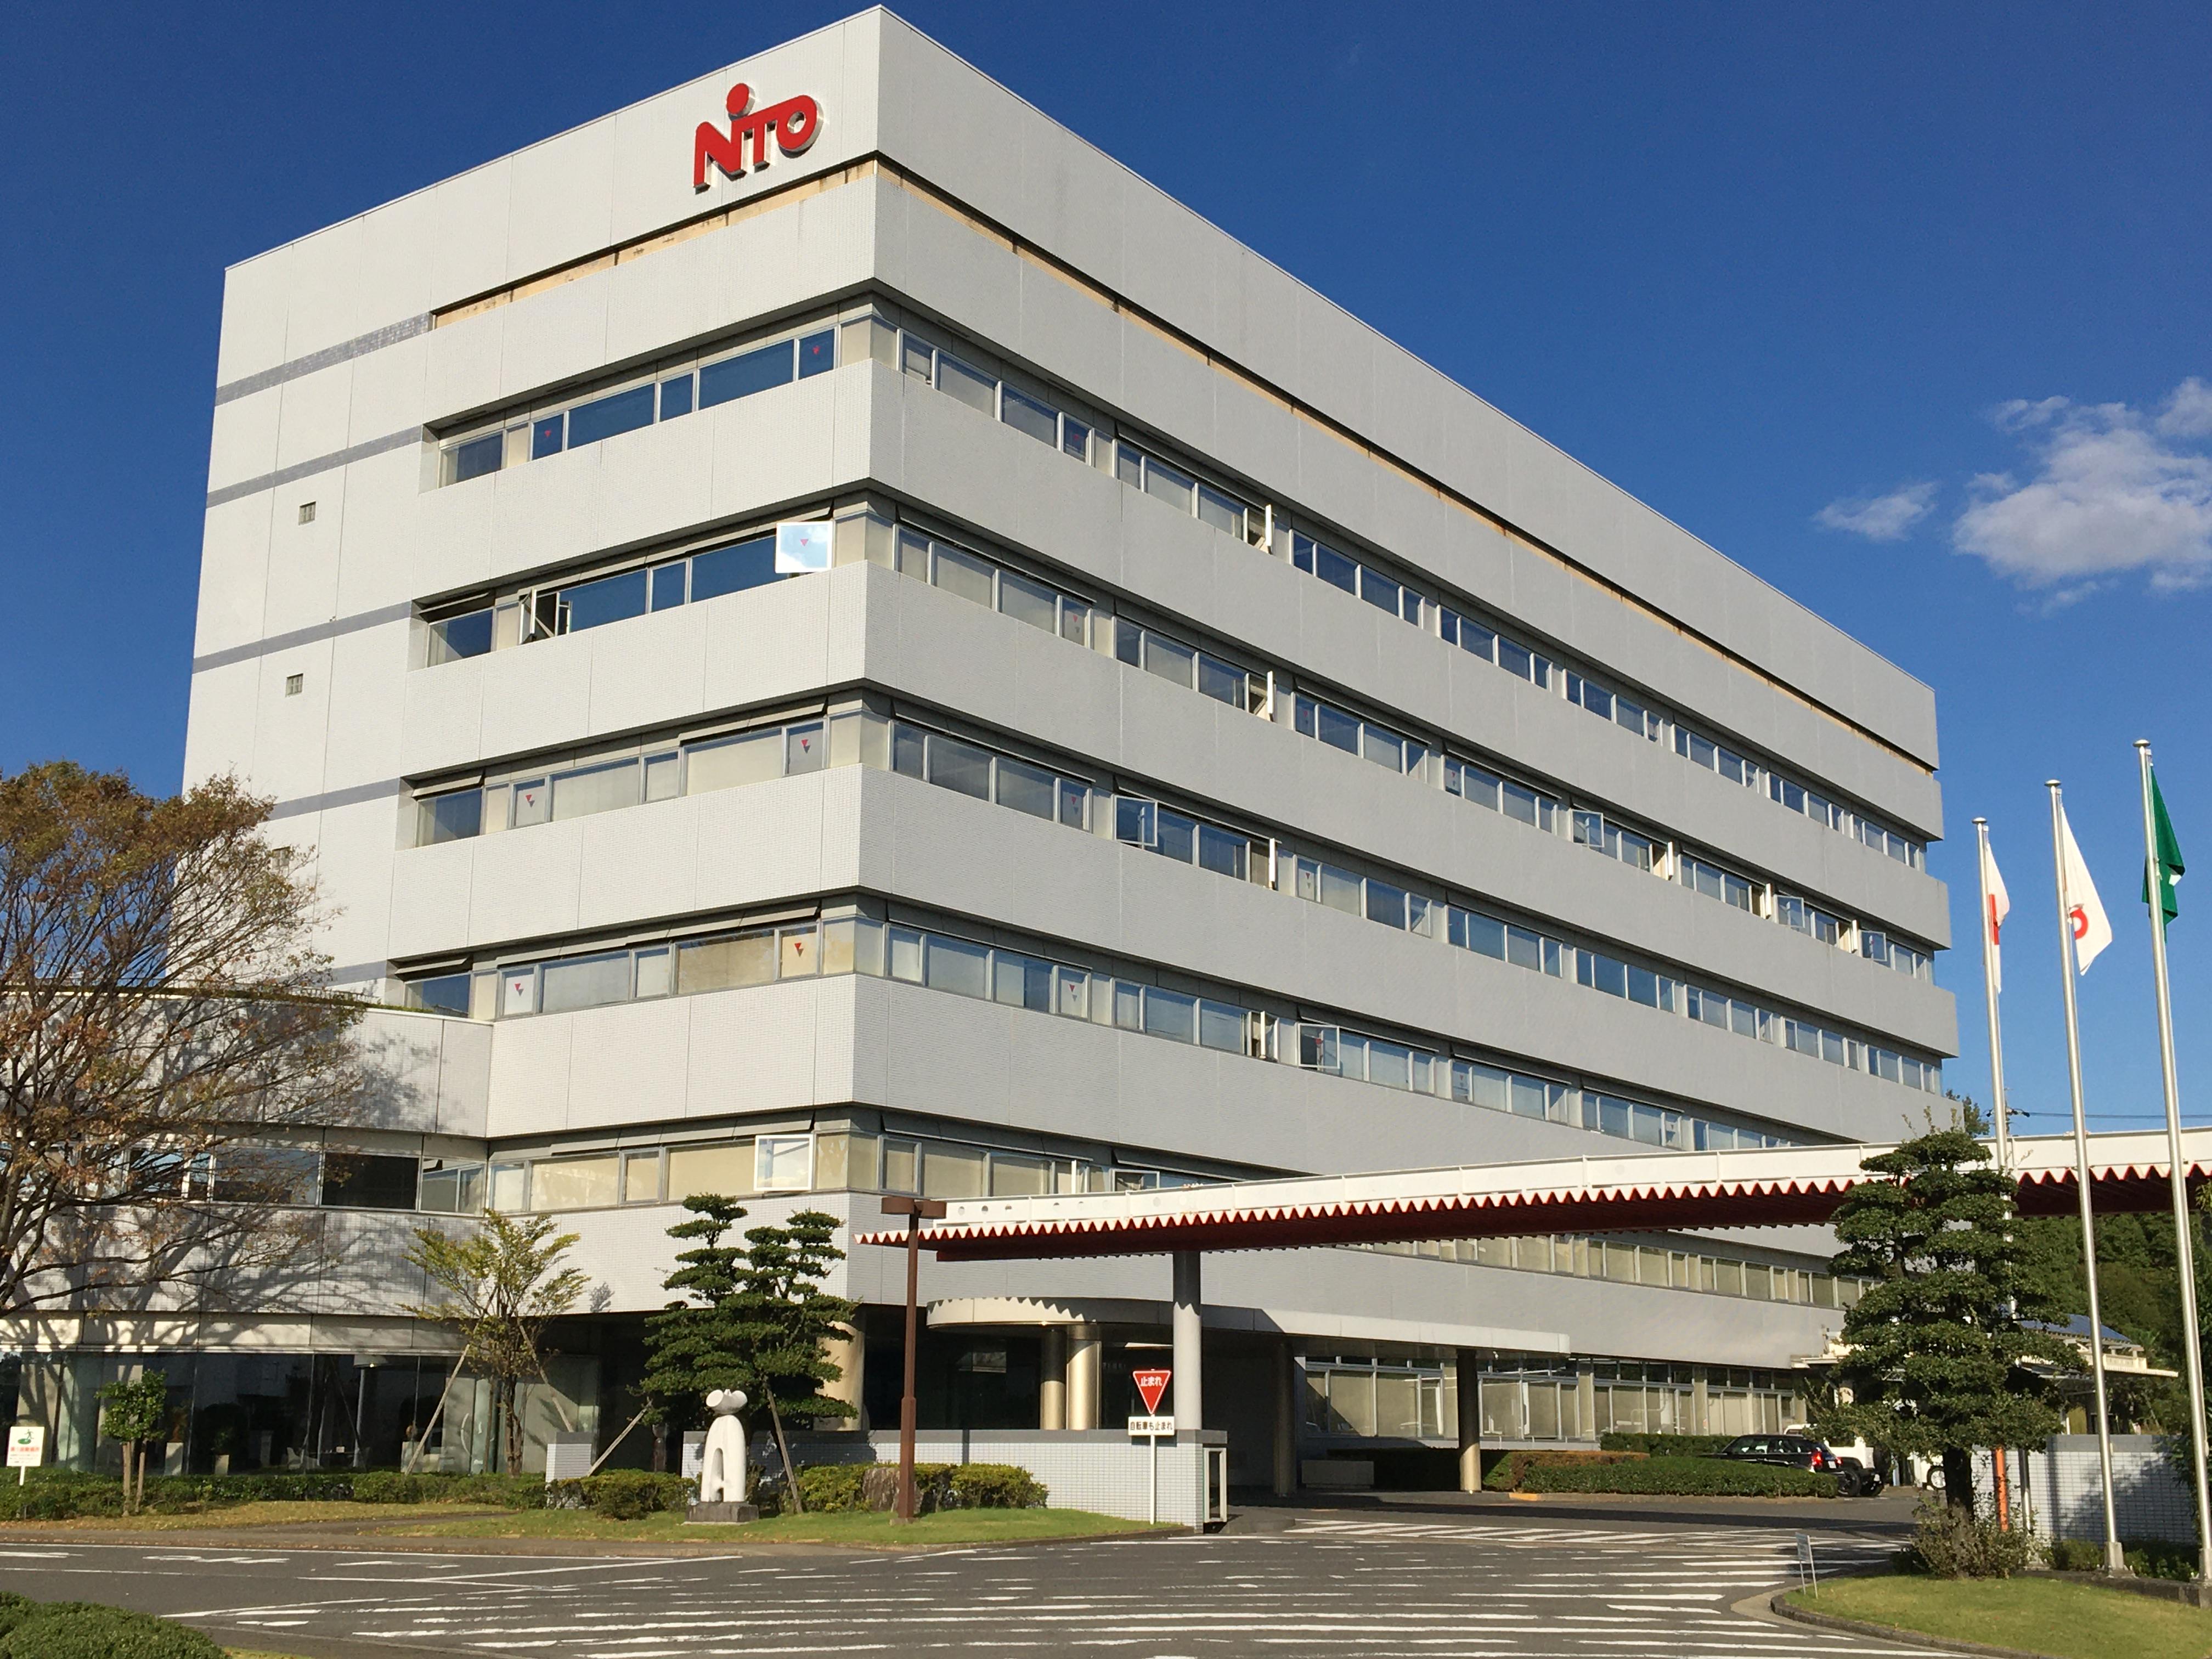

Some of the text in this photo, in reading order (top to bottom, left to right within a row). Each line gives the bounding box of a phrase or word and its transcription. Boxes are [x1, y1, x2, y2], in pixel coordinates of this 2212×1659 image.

[1140, 1376, 1163, 1387] 止まれ
[1130, 1421, 1173, 1431] 自転車も止まれ
